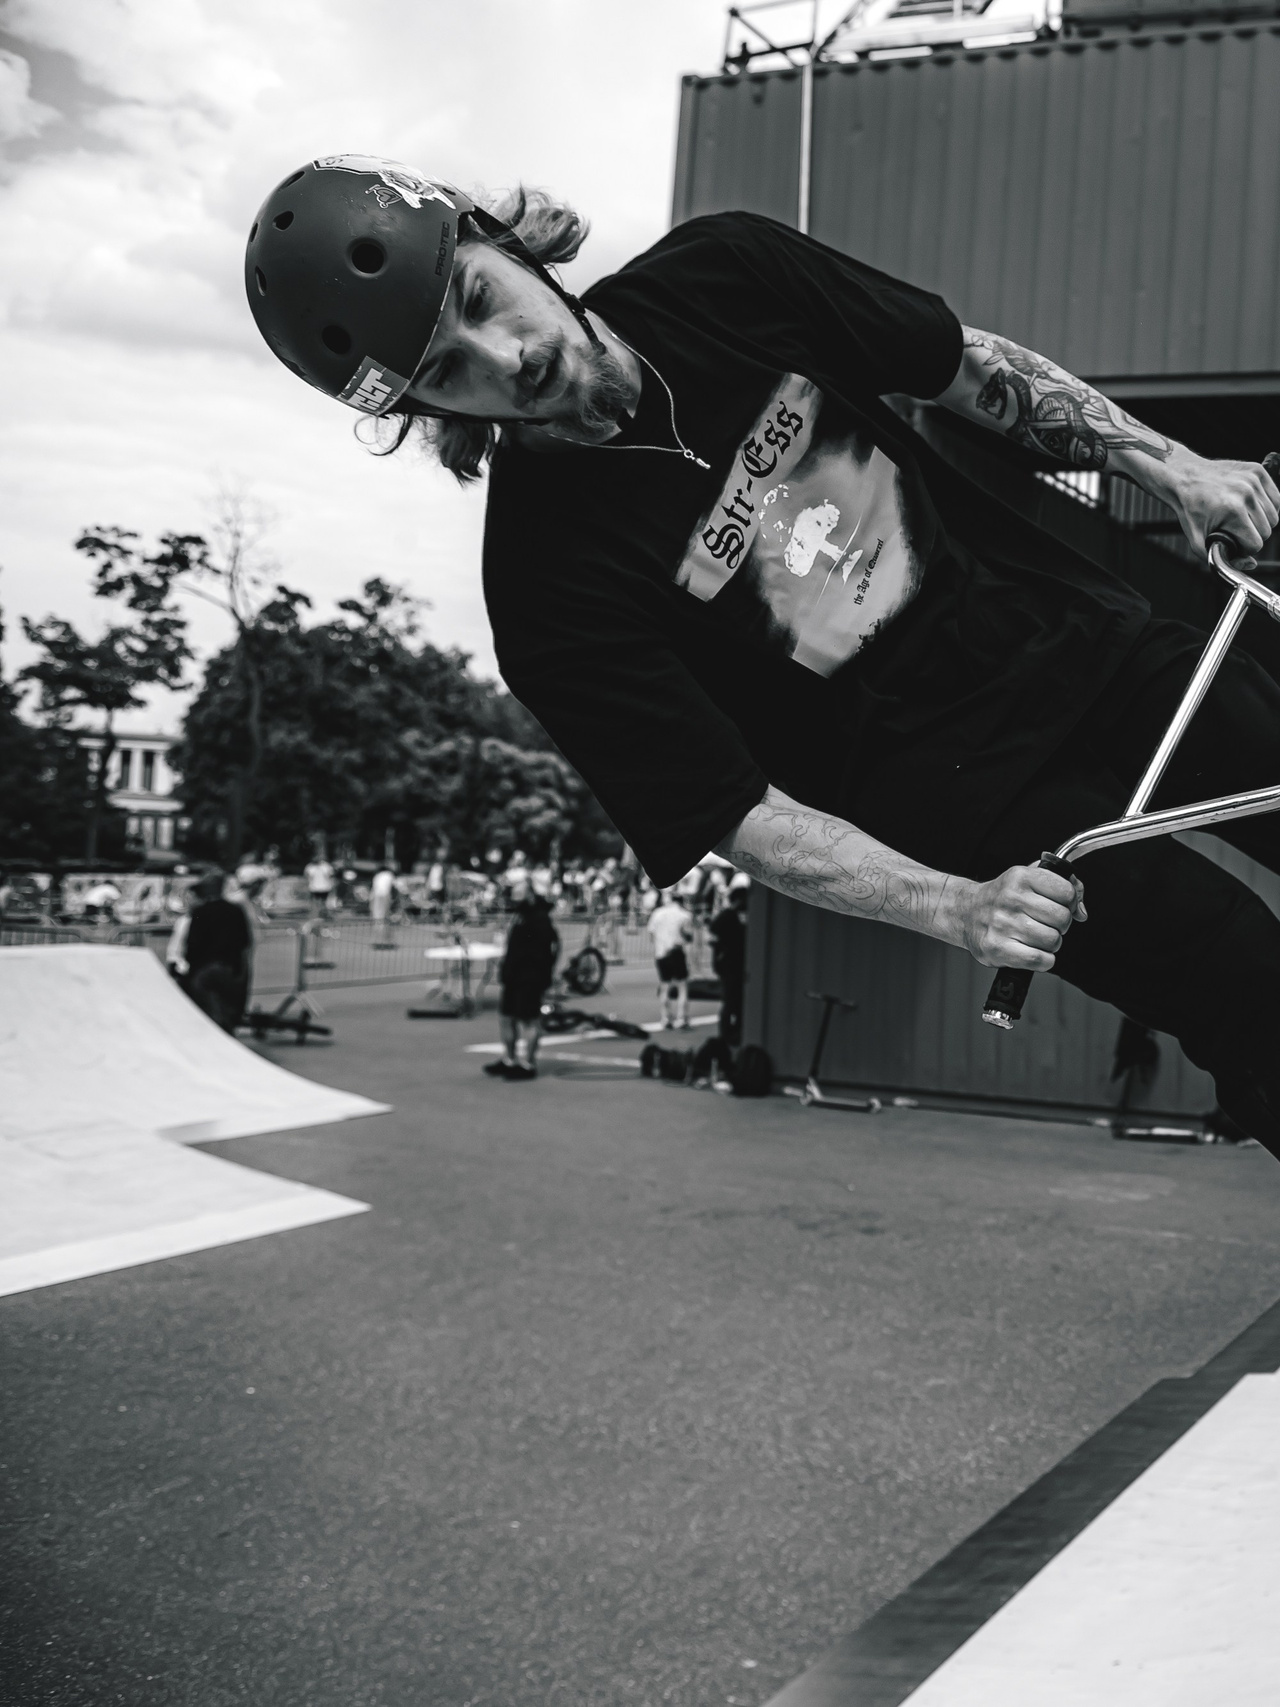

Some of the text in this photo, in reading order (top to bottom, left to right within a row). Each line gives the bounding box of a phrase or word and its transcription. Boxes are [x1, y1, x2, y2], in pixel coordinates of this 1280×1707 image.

[702, 400, 804, 570] Str-Ess
[864, 568, 873, 579] of
[857, 576, 870, 594] Age
[853, 591, 864, 606] the
